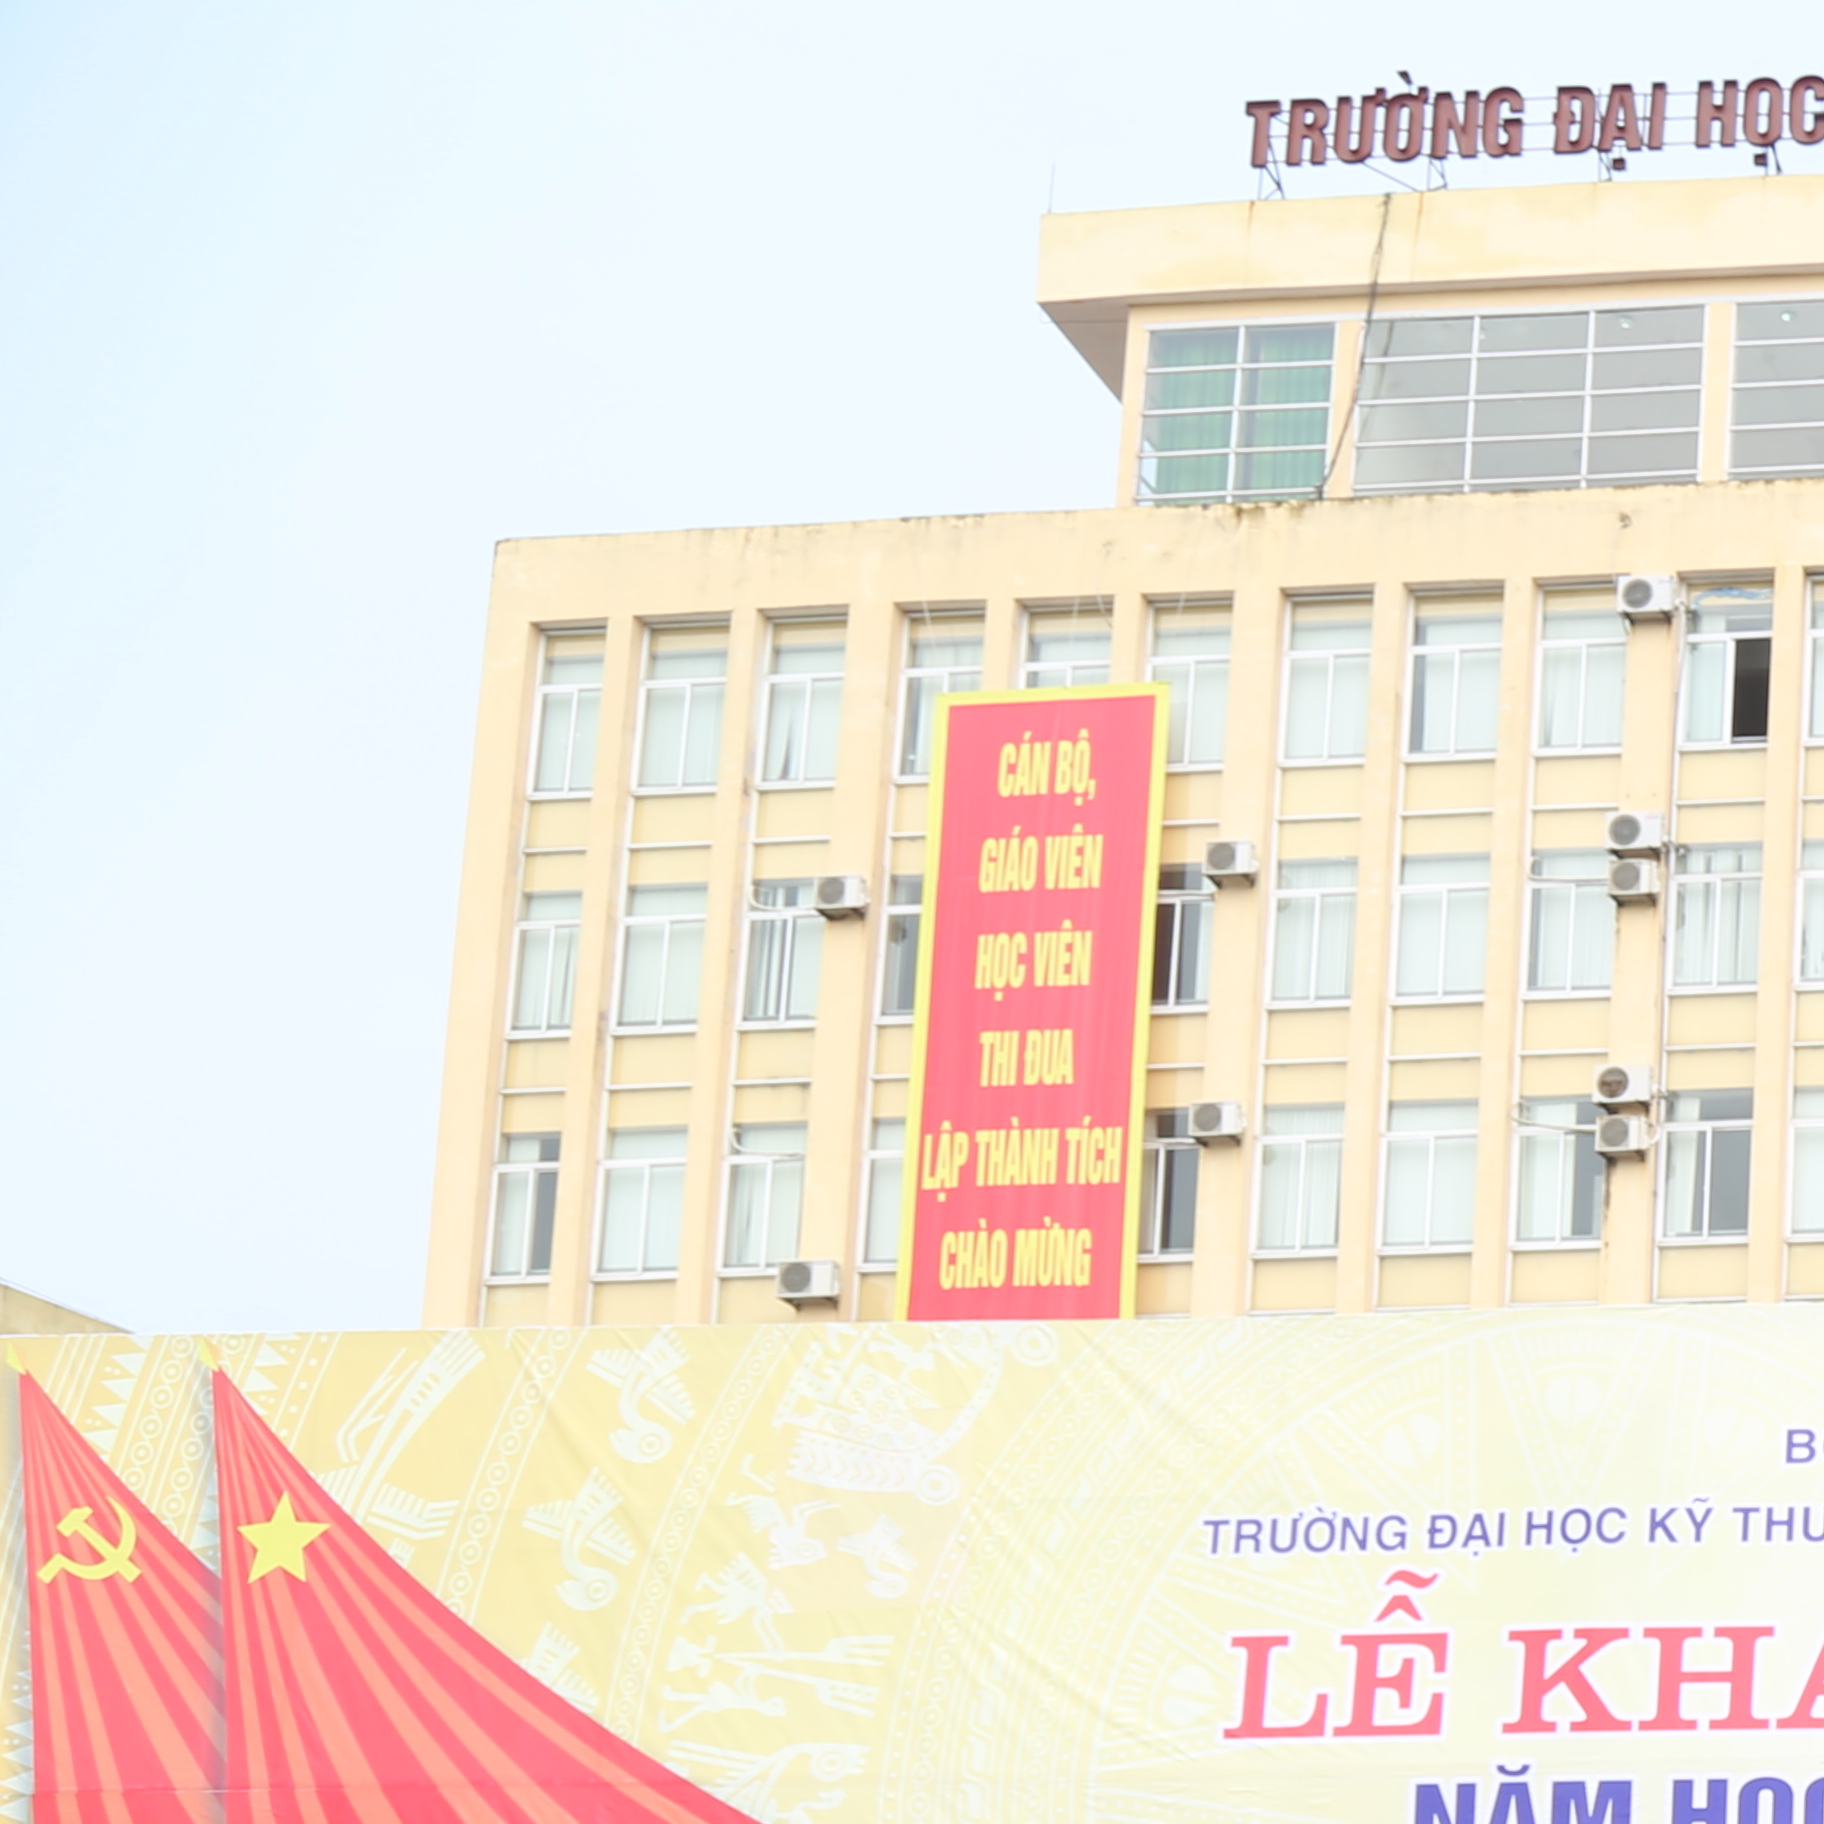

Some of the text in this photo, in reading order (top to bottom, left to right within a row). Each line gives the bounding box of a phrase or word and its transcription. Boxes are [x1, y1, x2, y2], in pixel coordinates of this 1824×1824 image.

[1245, 70, 1525, 168] TRƯỜNG
[1553, 82, 1667, 171] ĐẠI
[998, 728, 1096, 806] CÁN BỘ,
[979, 823, 1103, 893] GIÁO VIÊN
[974, 919, 1093, 1001] HỌC VIÊN
[980, 1029, 1074, 1087] THI ĐUA
[921, 1115, 1122, 1202] LẬP THÀNH TÍCH
[939, 1215, 1092, 1290] CHÀO MỪNG
[1203, 1506, 1408, 1555] TRƯỜNG
[1426, 1512, 1507, 1557] ĐẠI
[1523, 1507, 1629, 1553] HỌC
[1648, 1497, 1715, 1545] KỸ
[1223, 1569, 1449, 1739] LỄ
